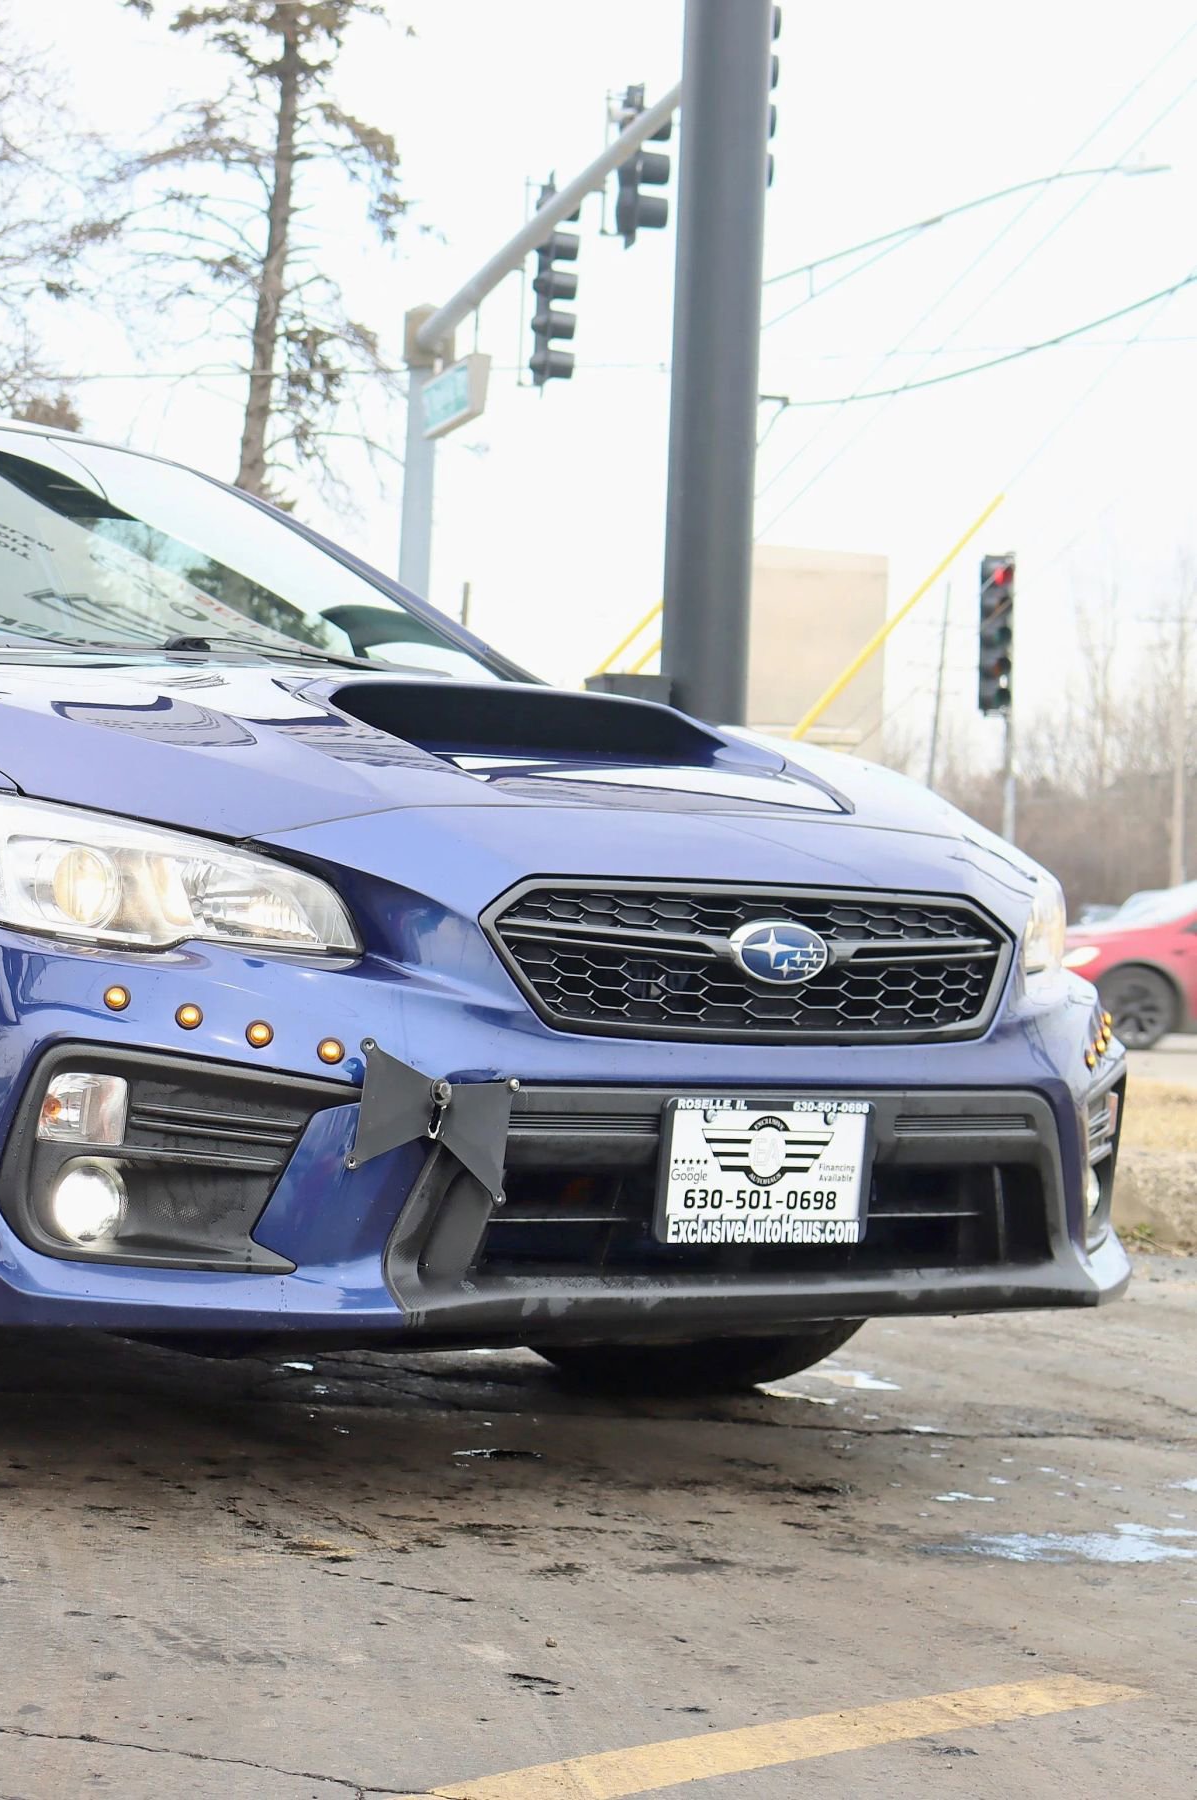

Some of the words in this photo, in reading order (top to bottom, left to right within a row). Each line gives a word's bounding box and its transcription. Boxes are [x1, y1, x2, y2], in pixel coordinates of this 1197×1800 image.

[735, 1099, 748, 1110] IL
[793, 1101, 870, 1114] 630-501-0698
[819, 1163, 855, 1172] Financing
[671, 1168, 708, 1184] Google
[819, 1174, 853, 1183] Available
[683, 1188, 837, 1210] 630-501-0698
[667, 1214, 860, 1244] ExclusiveAutoHaus.com
